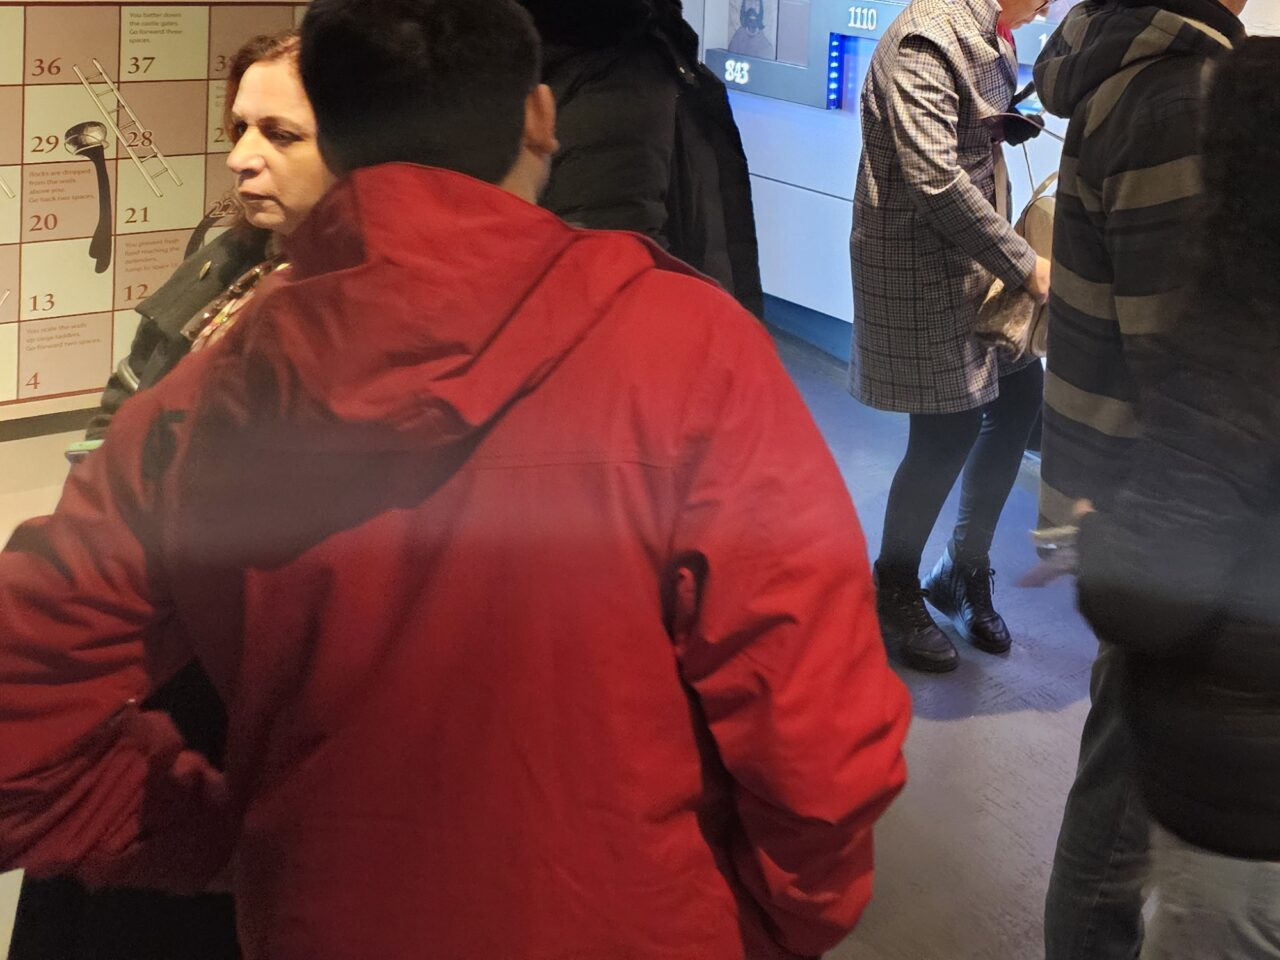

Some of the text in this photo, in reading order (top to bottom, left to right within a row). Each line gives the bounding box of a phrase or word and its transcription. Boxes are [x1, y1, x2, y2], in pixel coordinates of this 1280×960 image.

[848, 6, 877, 30] 1110
[31, 57, 61, 76] 36
[128, 56, 156, 74] 37
[725, 59, 749, 84] 843
[30, 135, 59, 154] 29
[127, 130, 153, 148] 28
[29, 213, 58, 232] 20
[124, 207, 150, 223] 21
[124, 284, 148, 301] 12
[30, 293, 55, 312] 13
[25, 372, 40, 390] 4
